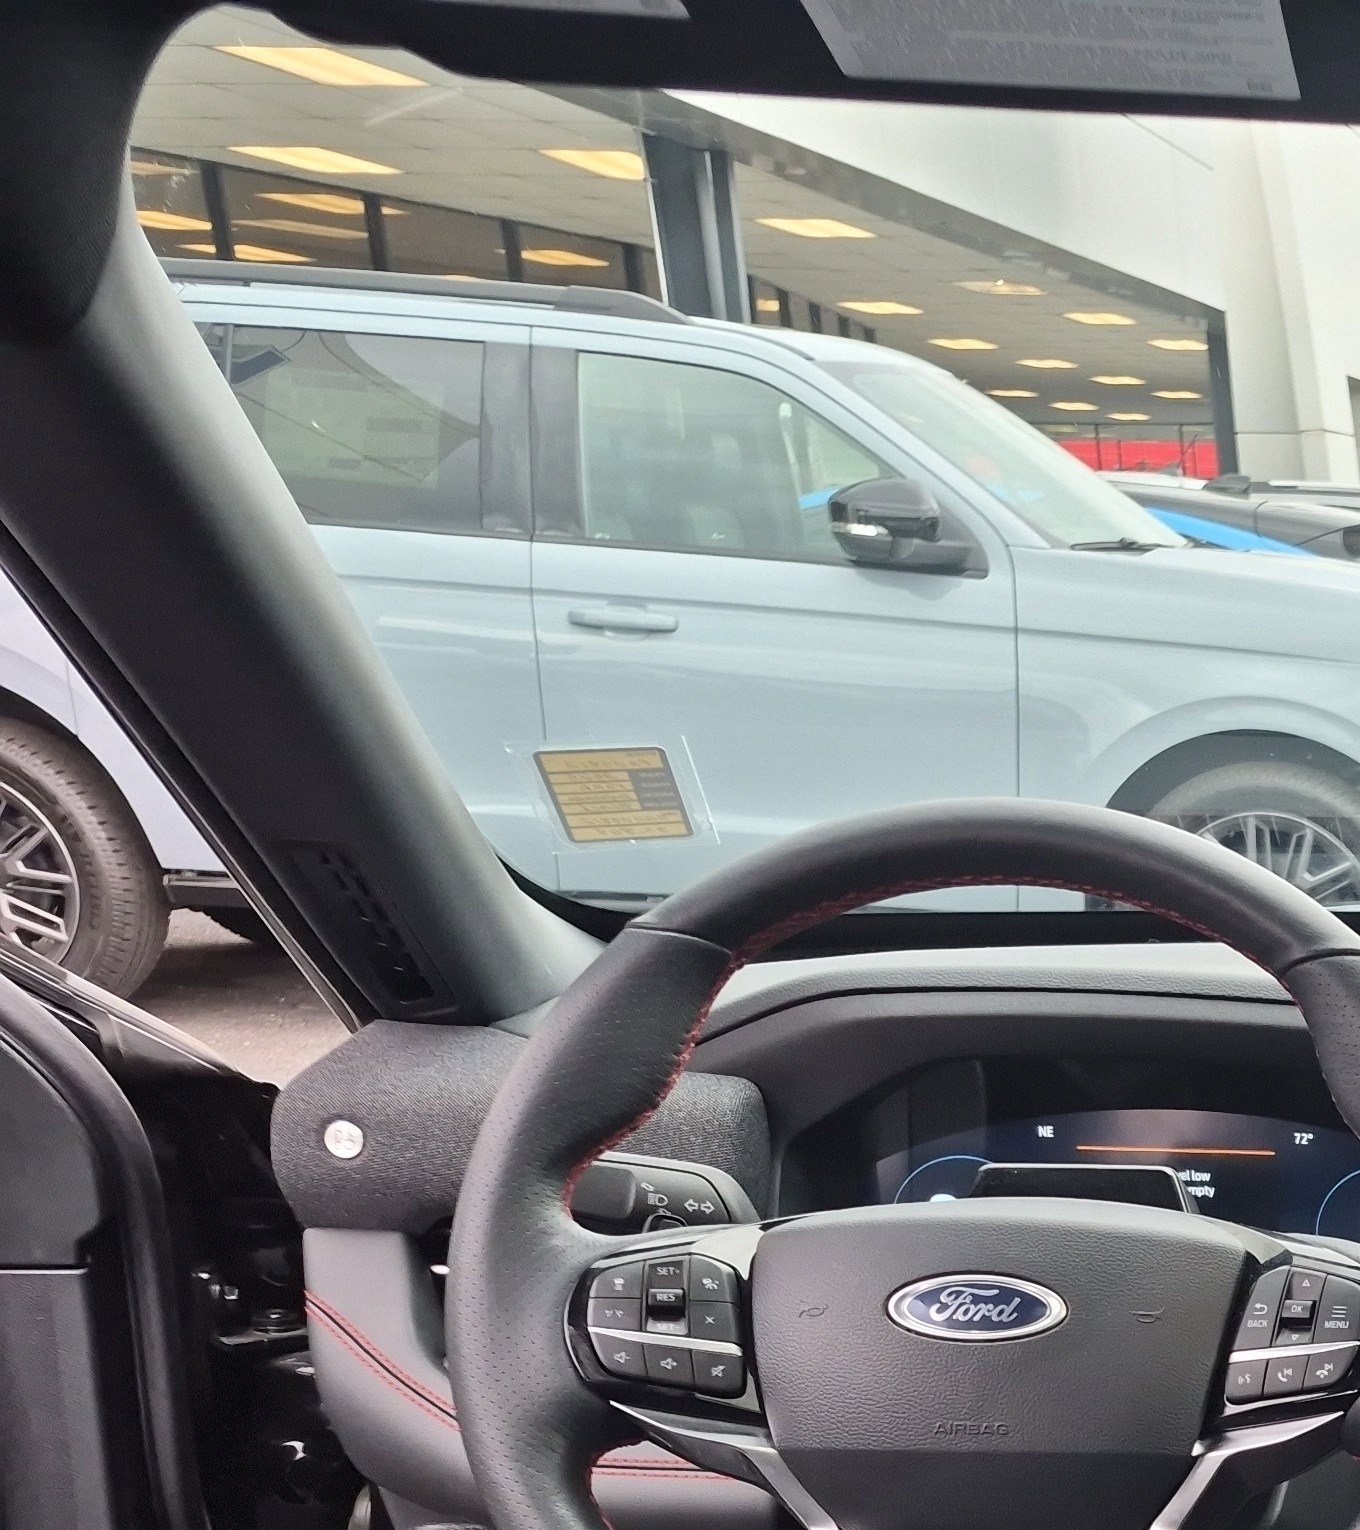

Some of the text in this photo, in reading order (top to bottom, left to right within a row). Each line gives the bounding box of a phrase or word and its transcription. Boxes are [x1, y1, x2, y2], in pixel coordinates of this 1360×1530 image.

[1037, 1125, 1055, 1138] NE
[1293, 1132, 1314, 1145] 72°
[1191, 1169, 1212, 1182] low
[1187, 1185, 1216, 1199] mpty
[656, 1293, 676, 1302] RES
[929, 1286, 1022, 1323] Ford
[1291, 1305, 1304, 1313] OK
[1247, 1320, 1269, 1328] BACK
[1324, 1320, 1350, 1329] MENU
[934, 1421, 1010, 1436] AIRBAG
